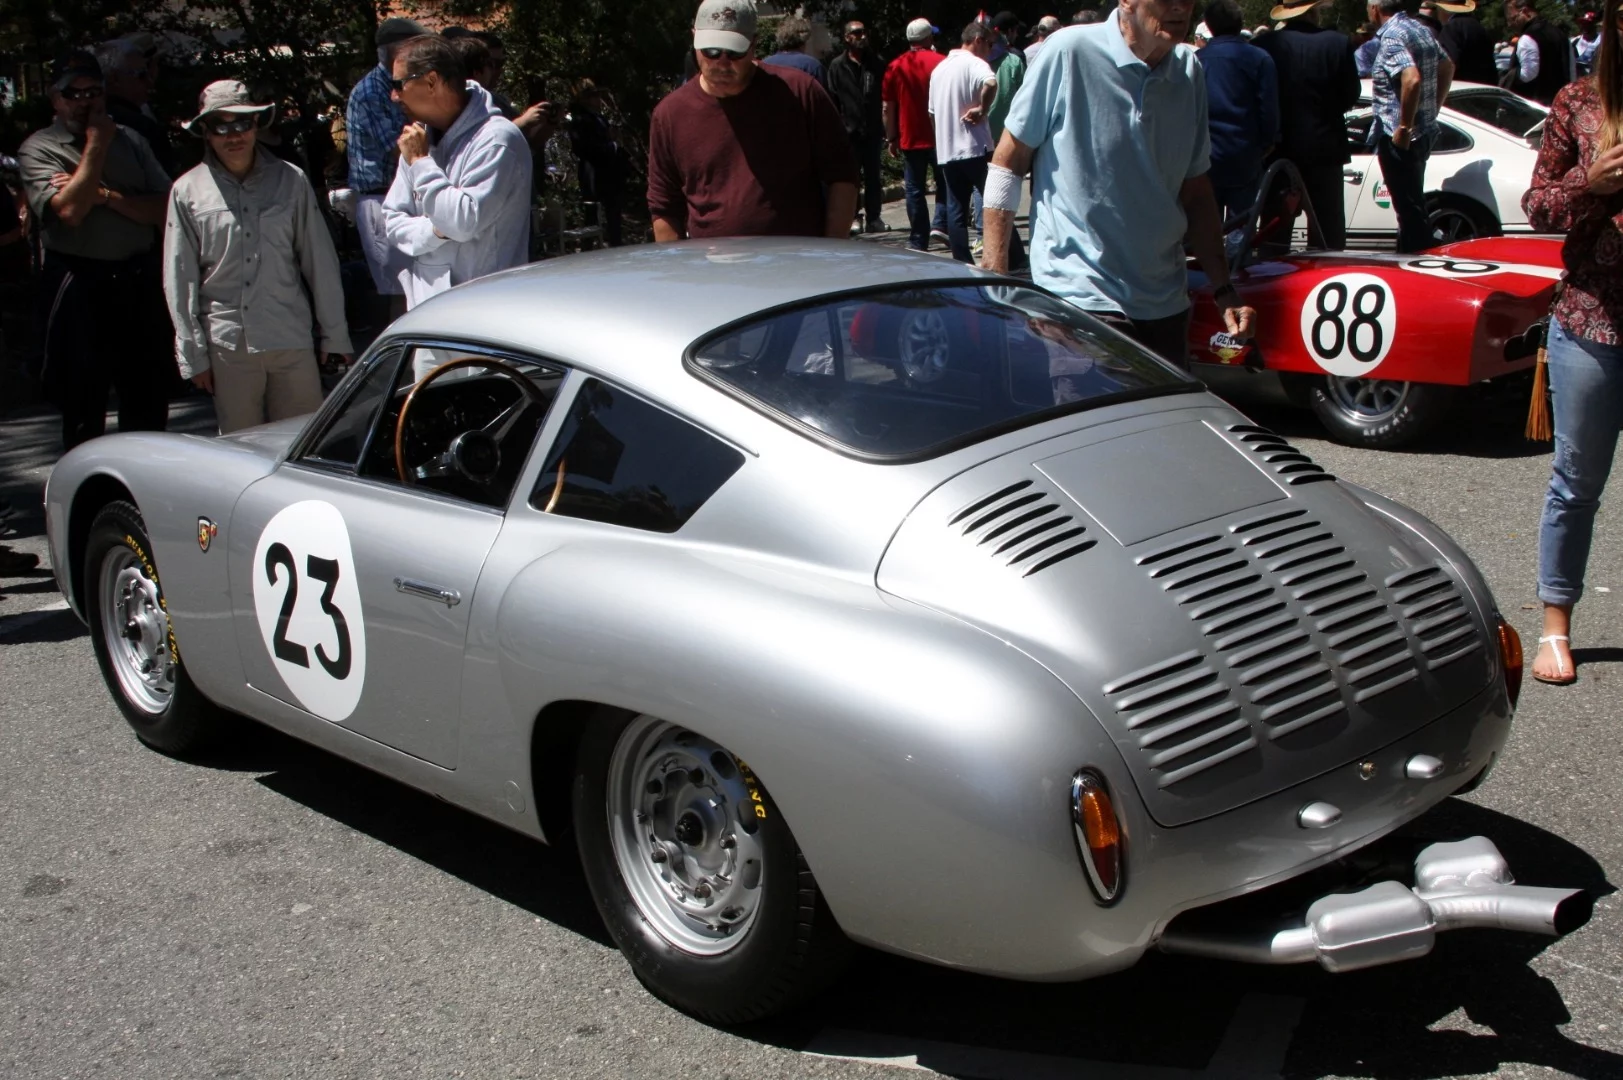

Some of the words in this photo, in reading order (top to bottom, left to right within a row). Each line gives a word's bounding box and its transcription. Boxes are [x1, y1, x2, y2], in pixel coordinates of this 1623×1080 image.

[1311, 281, 1386, 363] 88
[125, 534, 158, 583] DUNLOP
[265, 542, 352, 680] 23
[739, 760, 767, 818] CING
